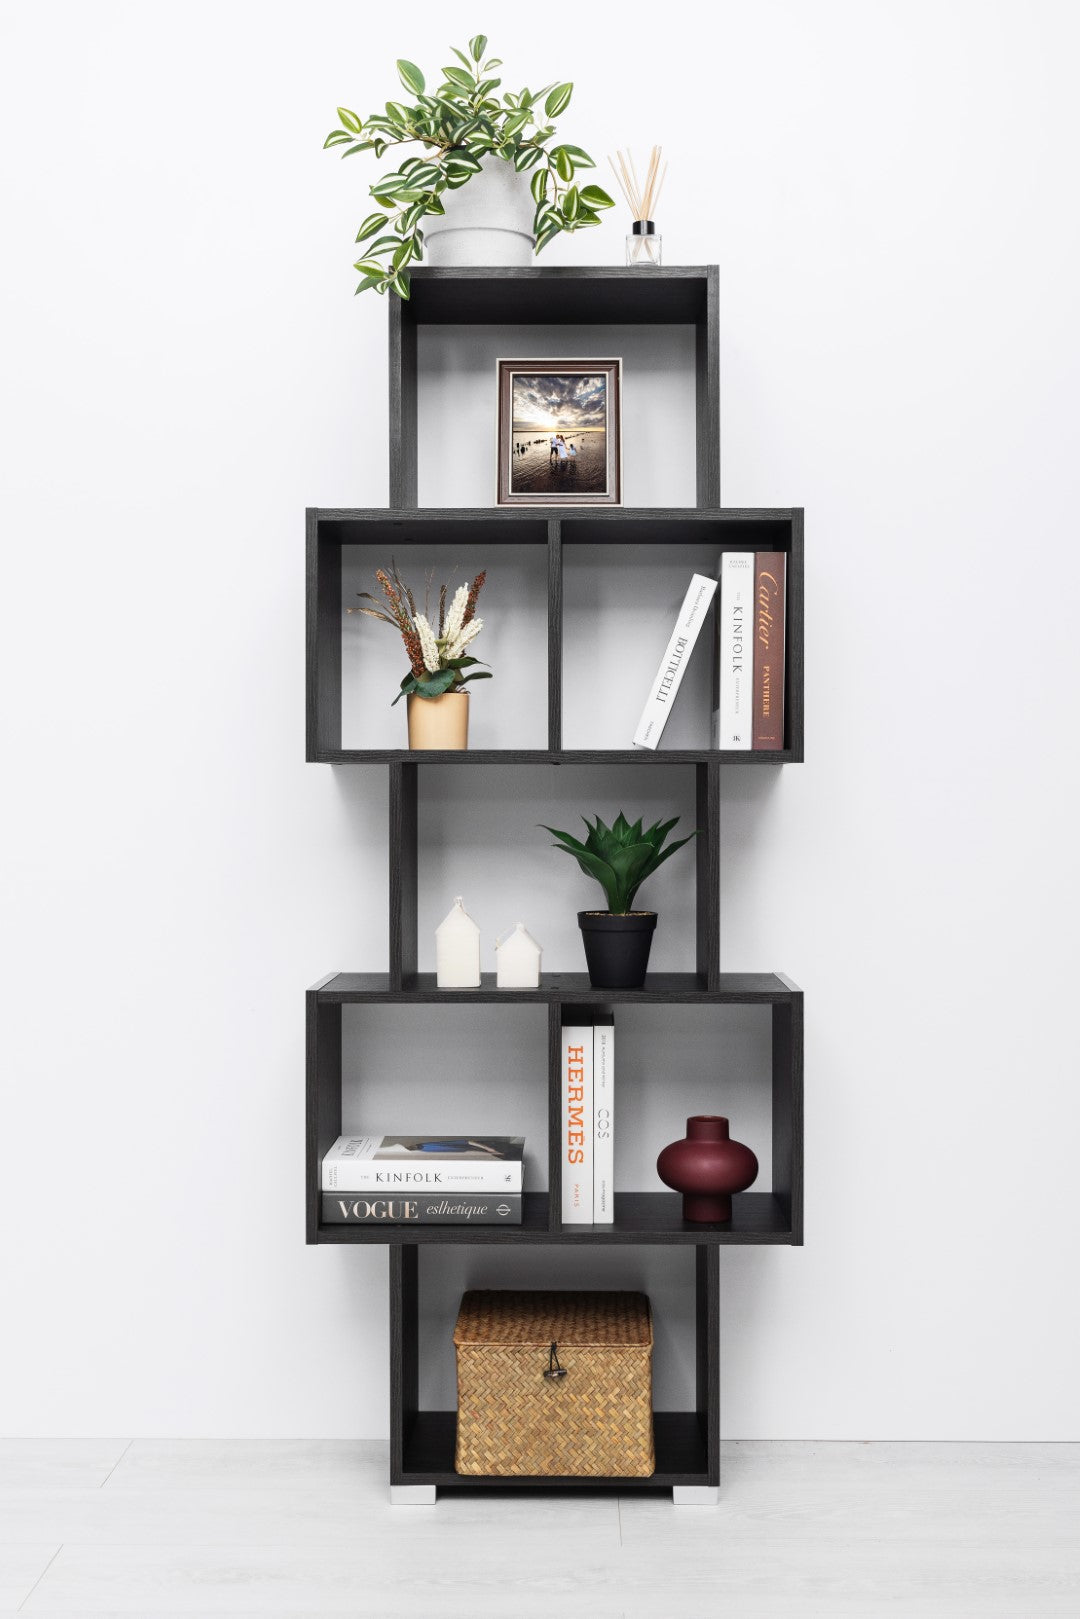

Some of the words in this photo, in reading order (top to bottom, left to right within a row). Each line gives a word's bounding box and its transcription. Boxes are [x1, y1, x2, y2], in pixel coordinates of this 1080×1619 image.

[759, 571, 778, 650] Cartier
[732, 606, 743, 673] KINFOLK
[656, 637, 688, 703] BOTTICELLI
[598, 1109, 610, 1139] COS
[376, 1172, 442, 1182] KINFOLK
[338, 1200, 419, 1219] VOGUE
